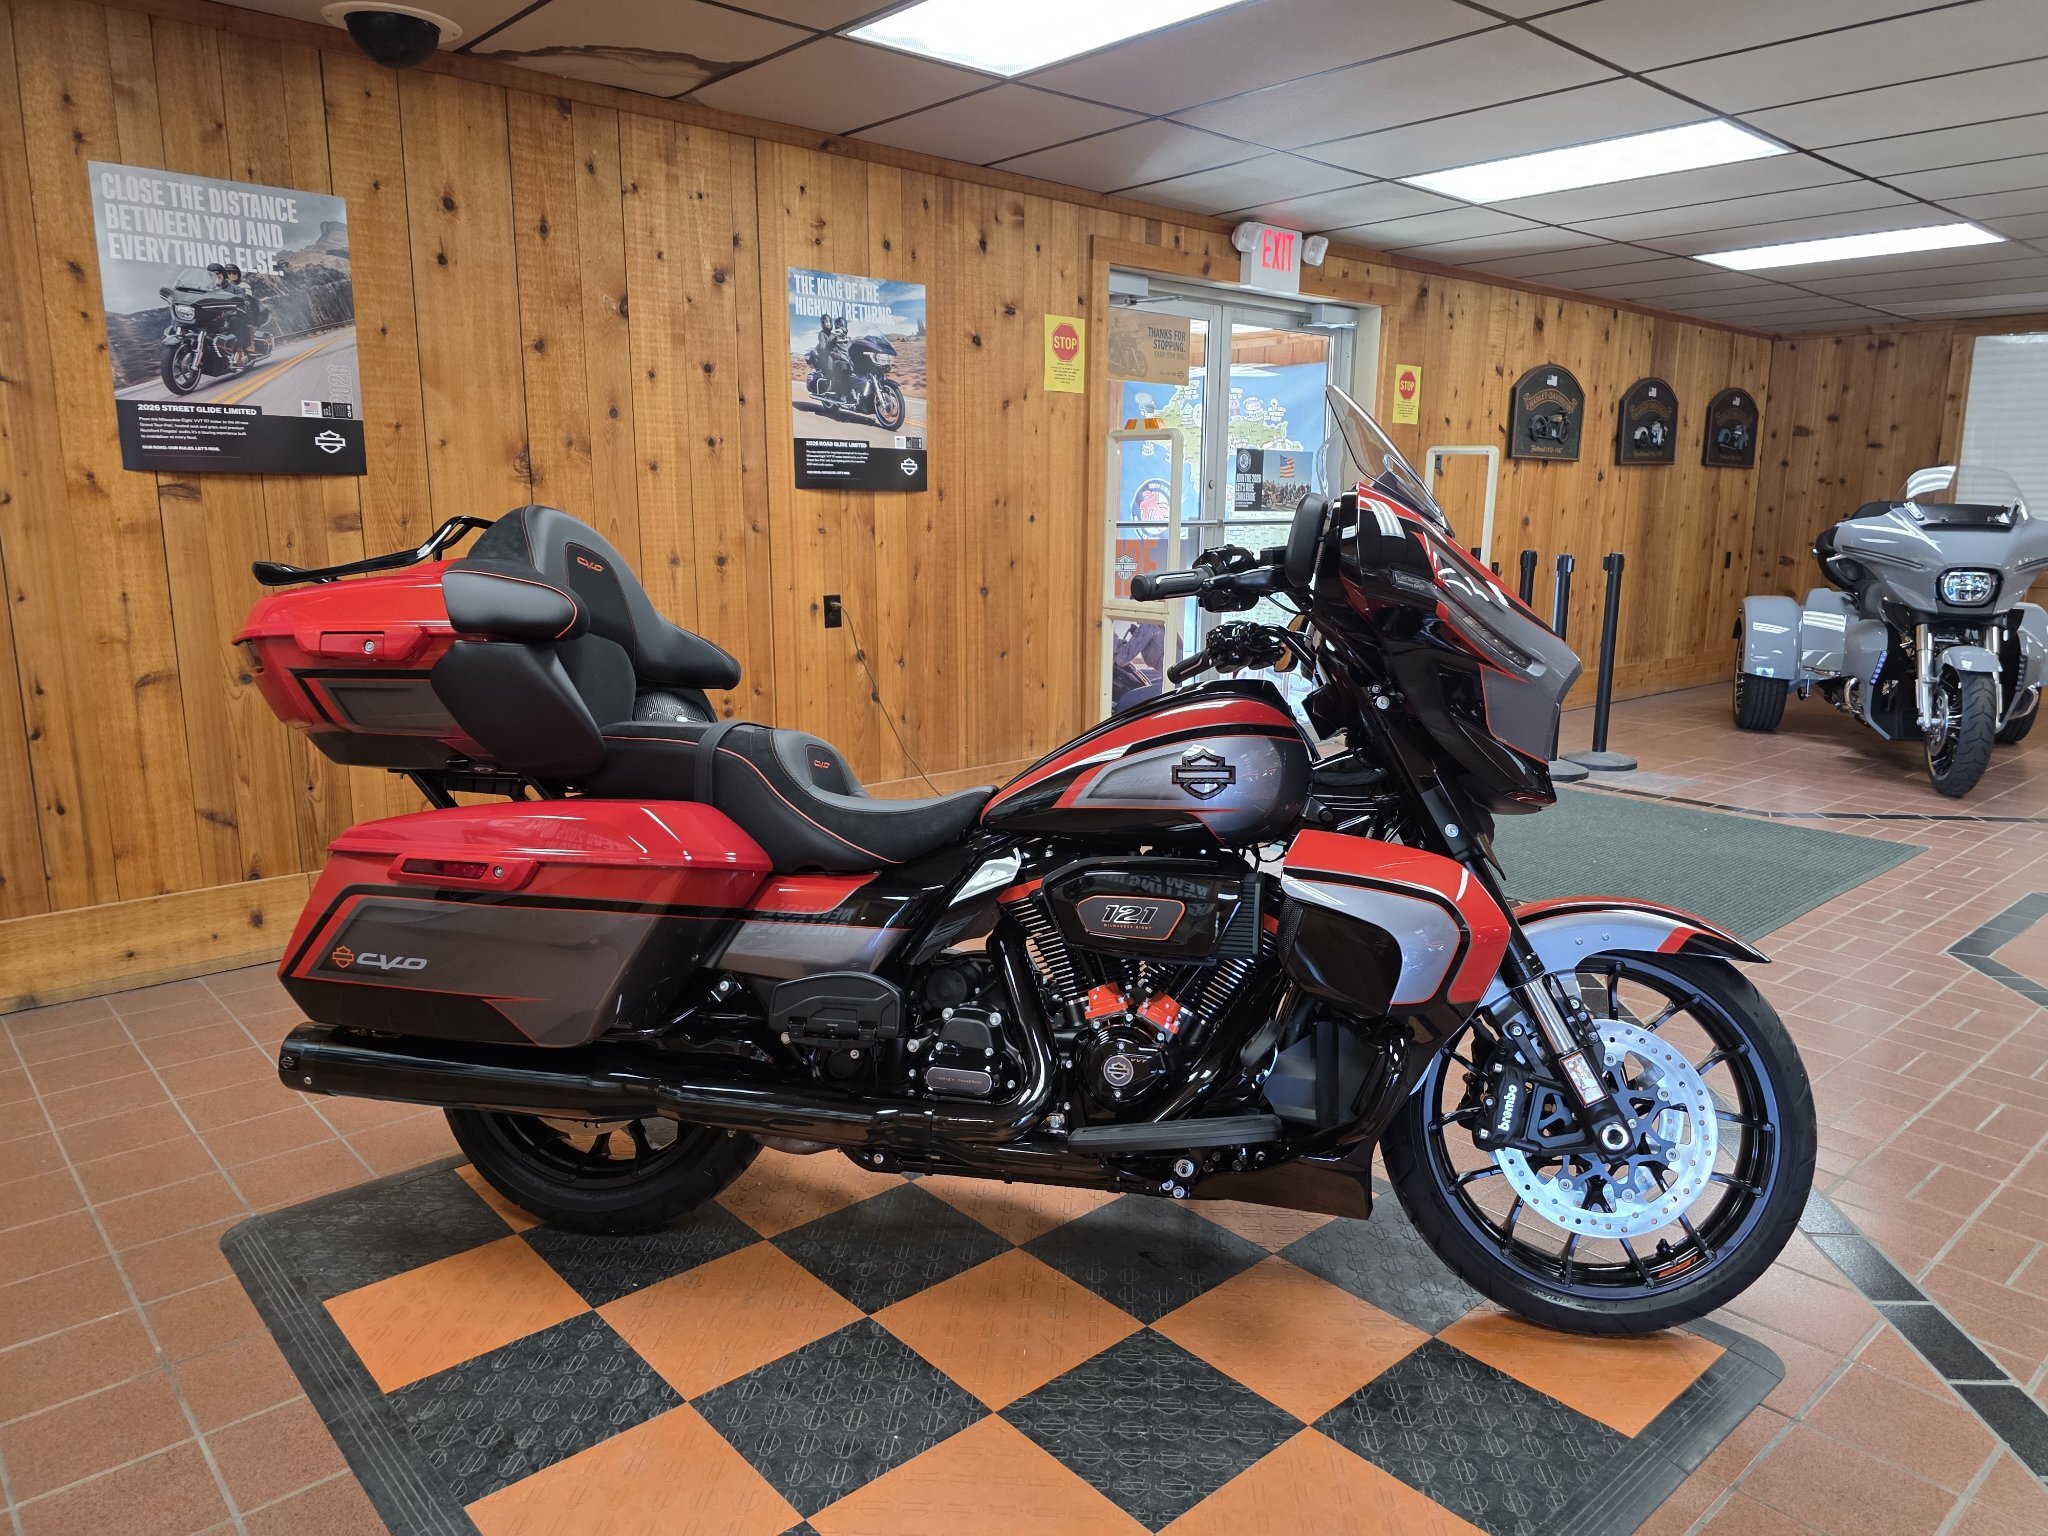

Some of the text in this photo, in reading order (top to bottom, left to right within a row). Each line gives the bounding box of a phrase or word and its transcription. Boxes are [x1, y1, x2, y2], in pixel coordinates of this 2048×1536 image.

[101, 173, 298, 223] CLOSE THE DISTANCE
[104, 202, 284, 249] BETWEEN YOU AND
[107, 232, 284, 276] EVERYTHING ELSE.
[1262, 228, 1294, 272] EXIT
[793, 274, 880, 304] THE KING OF THE
[794, 296, 895, 326] HIGHWAY RETURNS.
[1053, 335, 1077, 350] STOP
[1148, 327, 1186, 341] THANKS FOR
[1153, 339, 1185, 352] STOPPING.
[1400, 380, 1415, 391] STOP
[161, 404, 195, 413] STREET
[196, 406, 222, 414] GLIDE
[223, 408, 257, 416] LIMITED
[577, 556, 603, 572] CVO
[1101, 904, 1159, 925] 121
[357, 953, 428, 970] CVO
[1498, 1084, 1518, 1131] brembo
